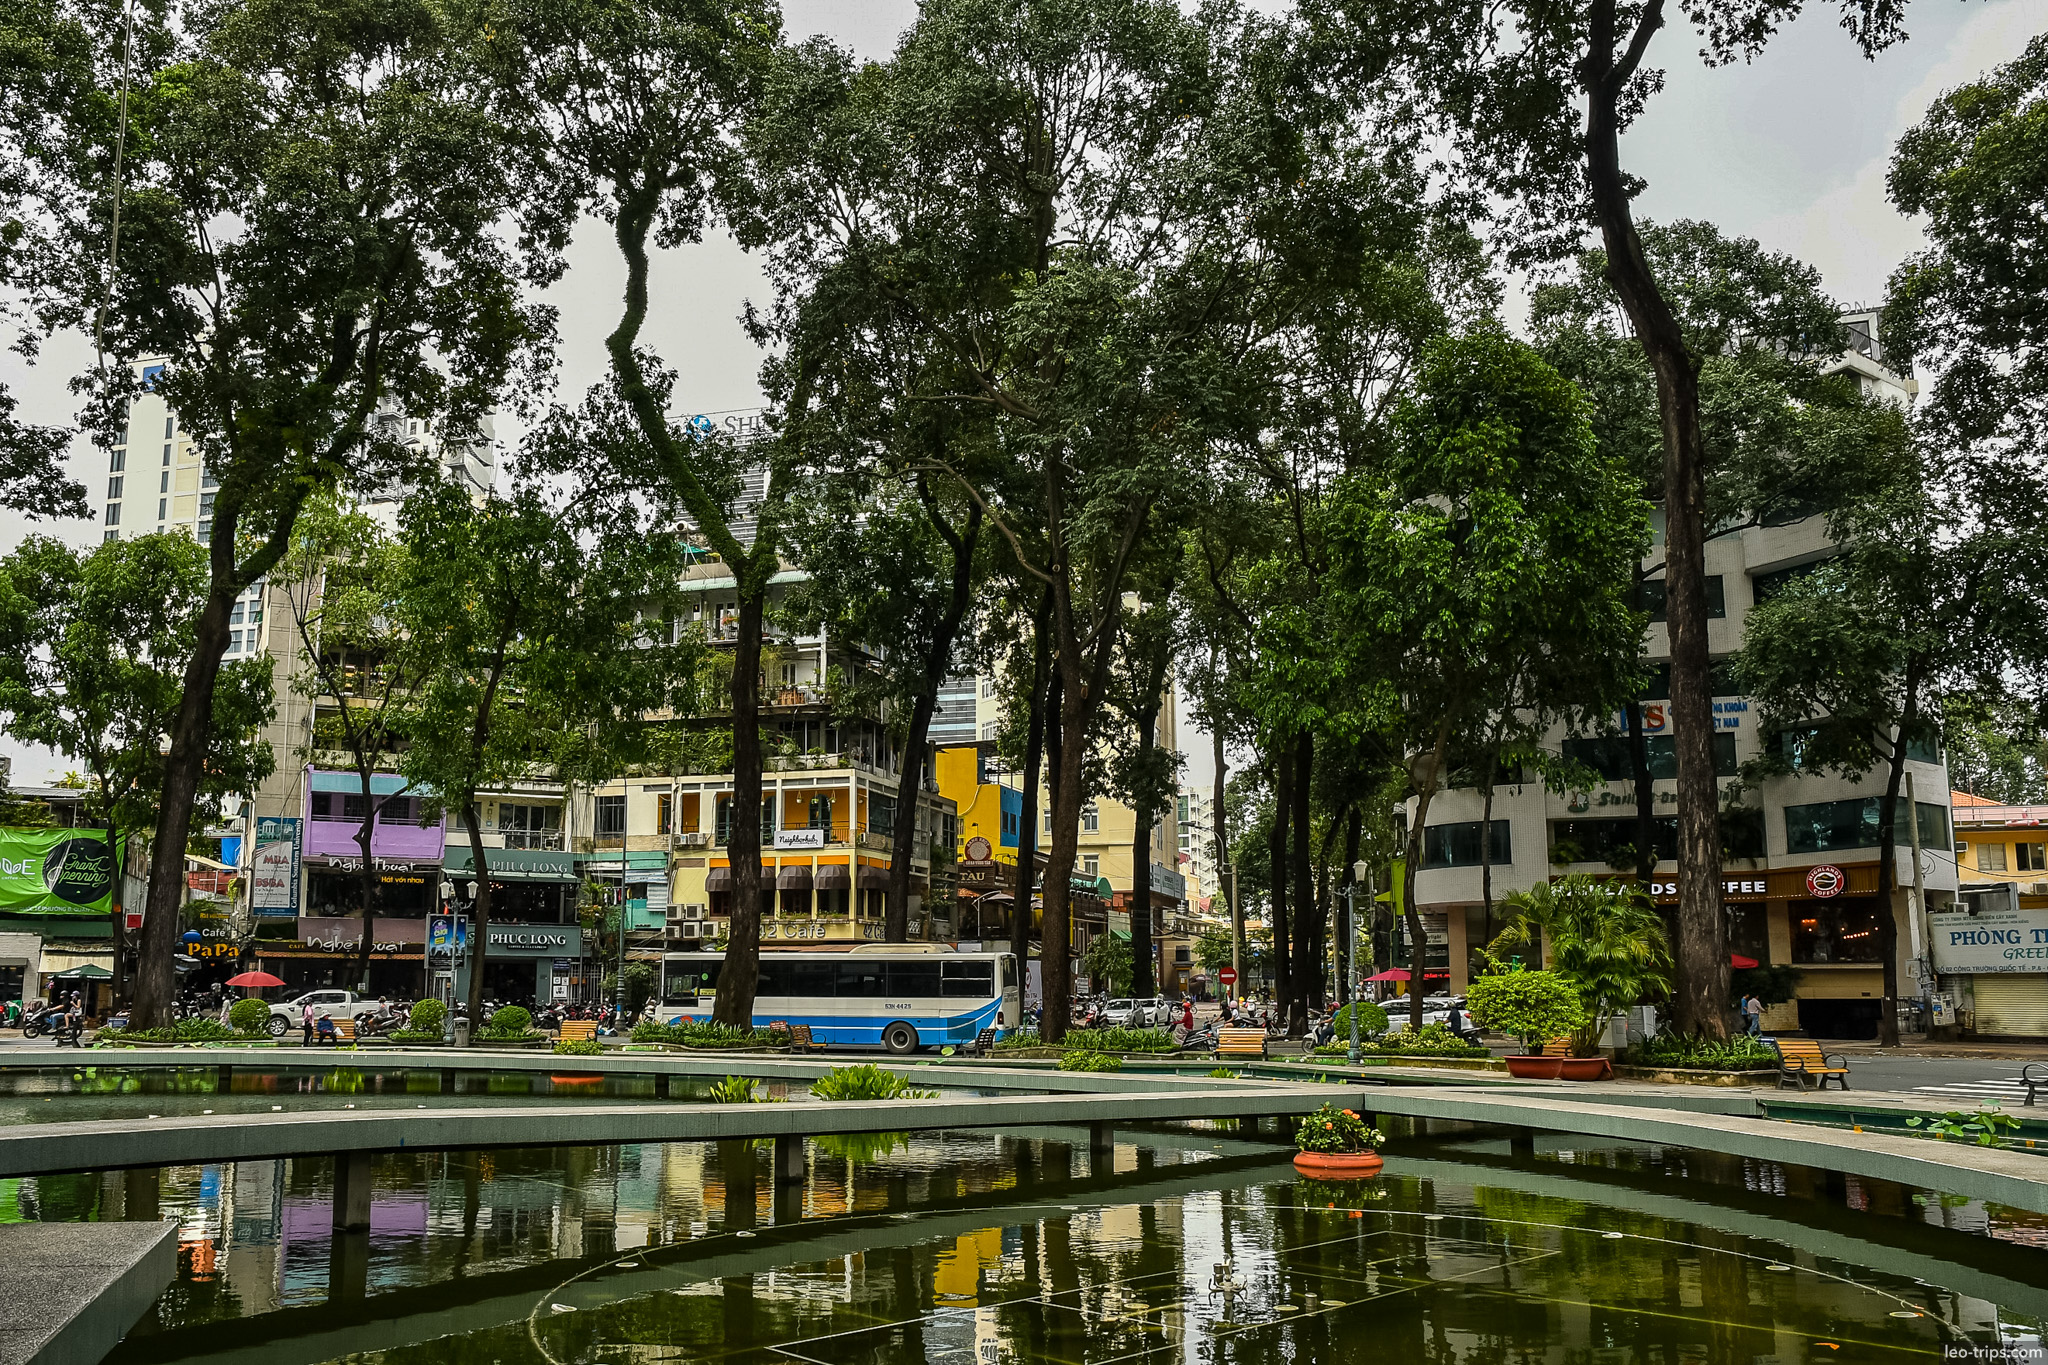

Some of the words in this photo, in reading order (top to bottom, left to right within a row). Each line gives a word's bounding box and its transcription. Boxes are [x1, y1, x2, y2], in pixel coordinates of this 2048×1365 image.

[294, 819, 302, 849] University
[533, 862, 568, 873] LONG
[407, 876, 424, 884] nhau
[1809, 867, 1841, 881] HIGHLANDS
[1813, 887, 1838, 896] COFFEE
[759, 924, 777, 938] 42
[1949, 926, 2022, 946] PHÒNG
[490, 933, 527, 944] PHUC
[531, 934, 566, 945] LONG
[1972, 964, 1999, 972] TRƯỜNG
[1999, 964, 2017, 972] QUỐC
